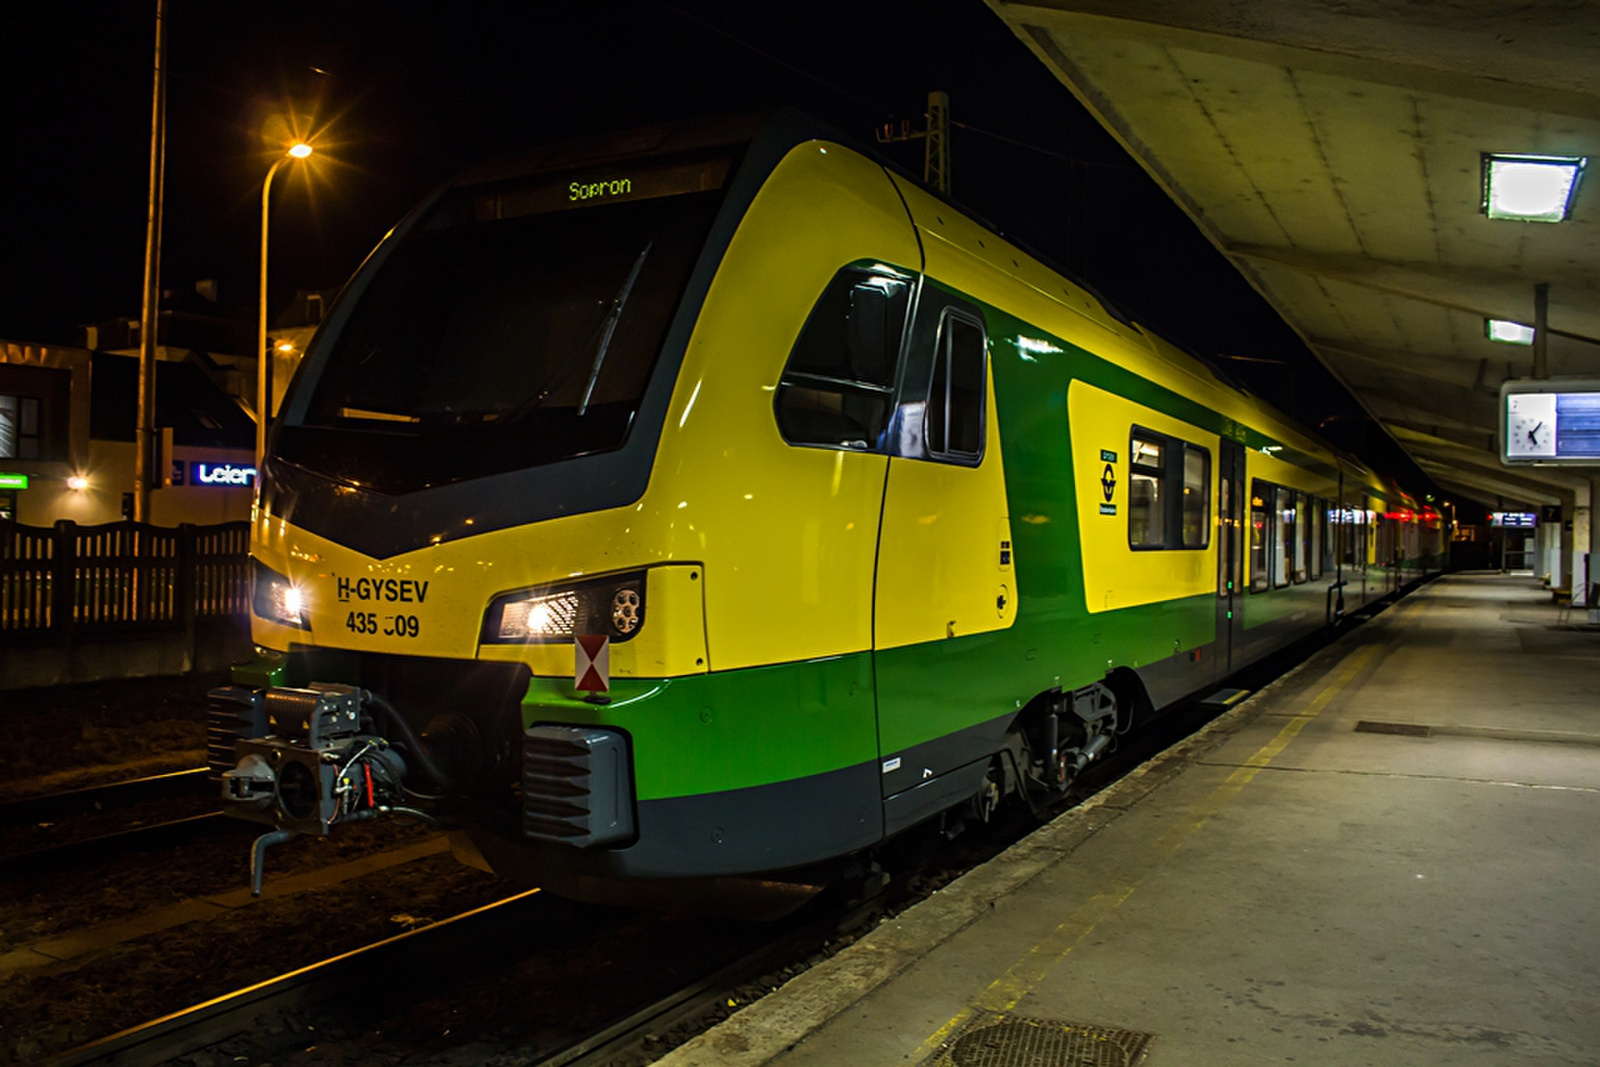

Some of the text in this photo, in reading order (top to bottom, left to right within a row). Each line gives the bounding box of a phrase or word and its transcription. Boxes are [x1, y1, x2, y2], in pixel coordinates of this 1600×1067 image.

[569, 179, 631, 200] Sopron
[199, 464, 257, 485] Leier
[337, 577, 429, 603] H-GYSEV
[346, 611, 378, 635] 435
